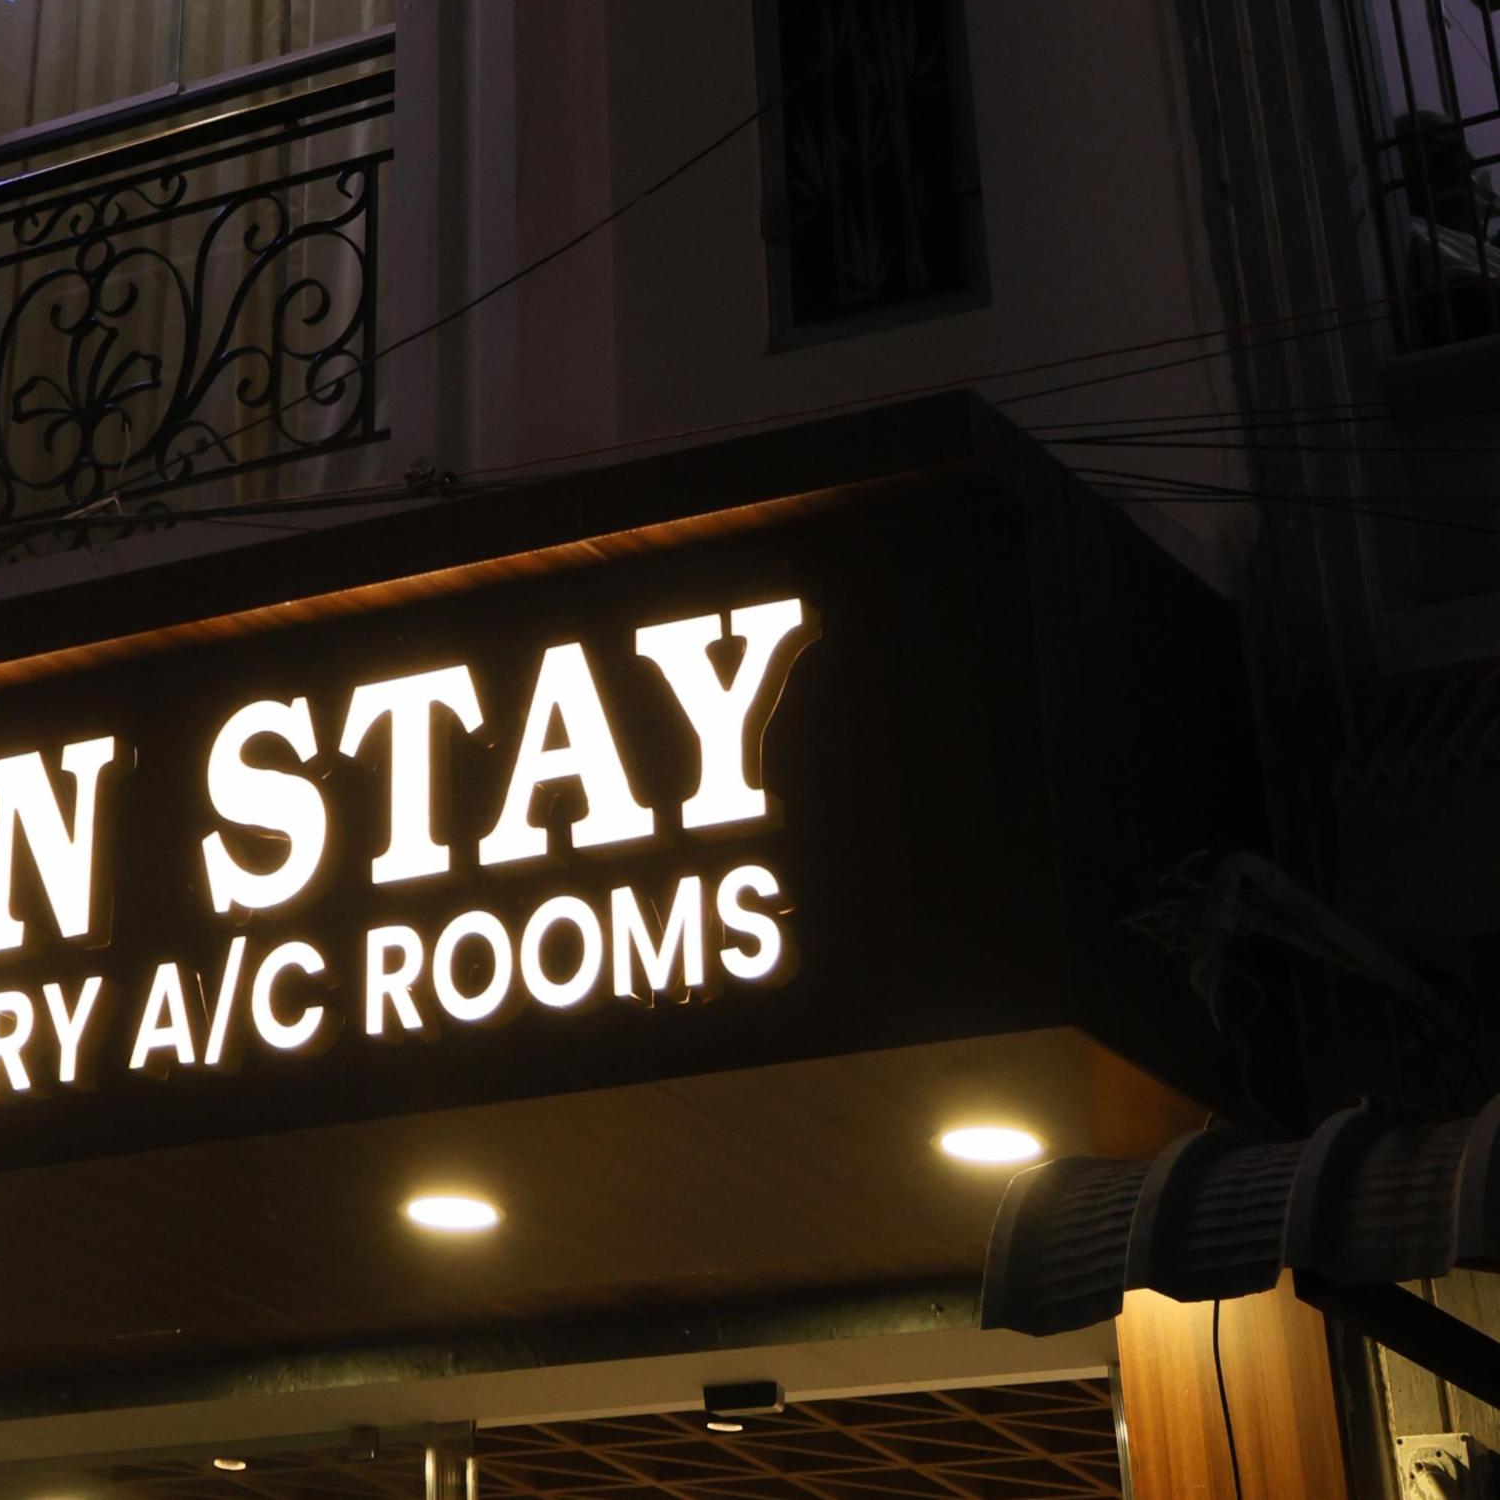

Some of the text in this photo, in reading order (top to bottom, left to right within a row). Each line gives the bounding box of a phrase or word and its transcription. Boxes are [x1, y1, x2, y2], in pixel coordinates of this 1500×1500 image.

[202, 598, 802, 913] STAY
[129, 936, 325, 1069] A/C
[366, 865, 781, 1035] ROOMS
